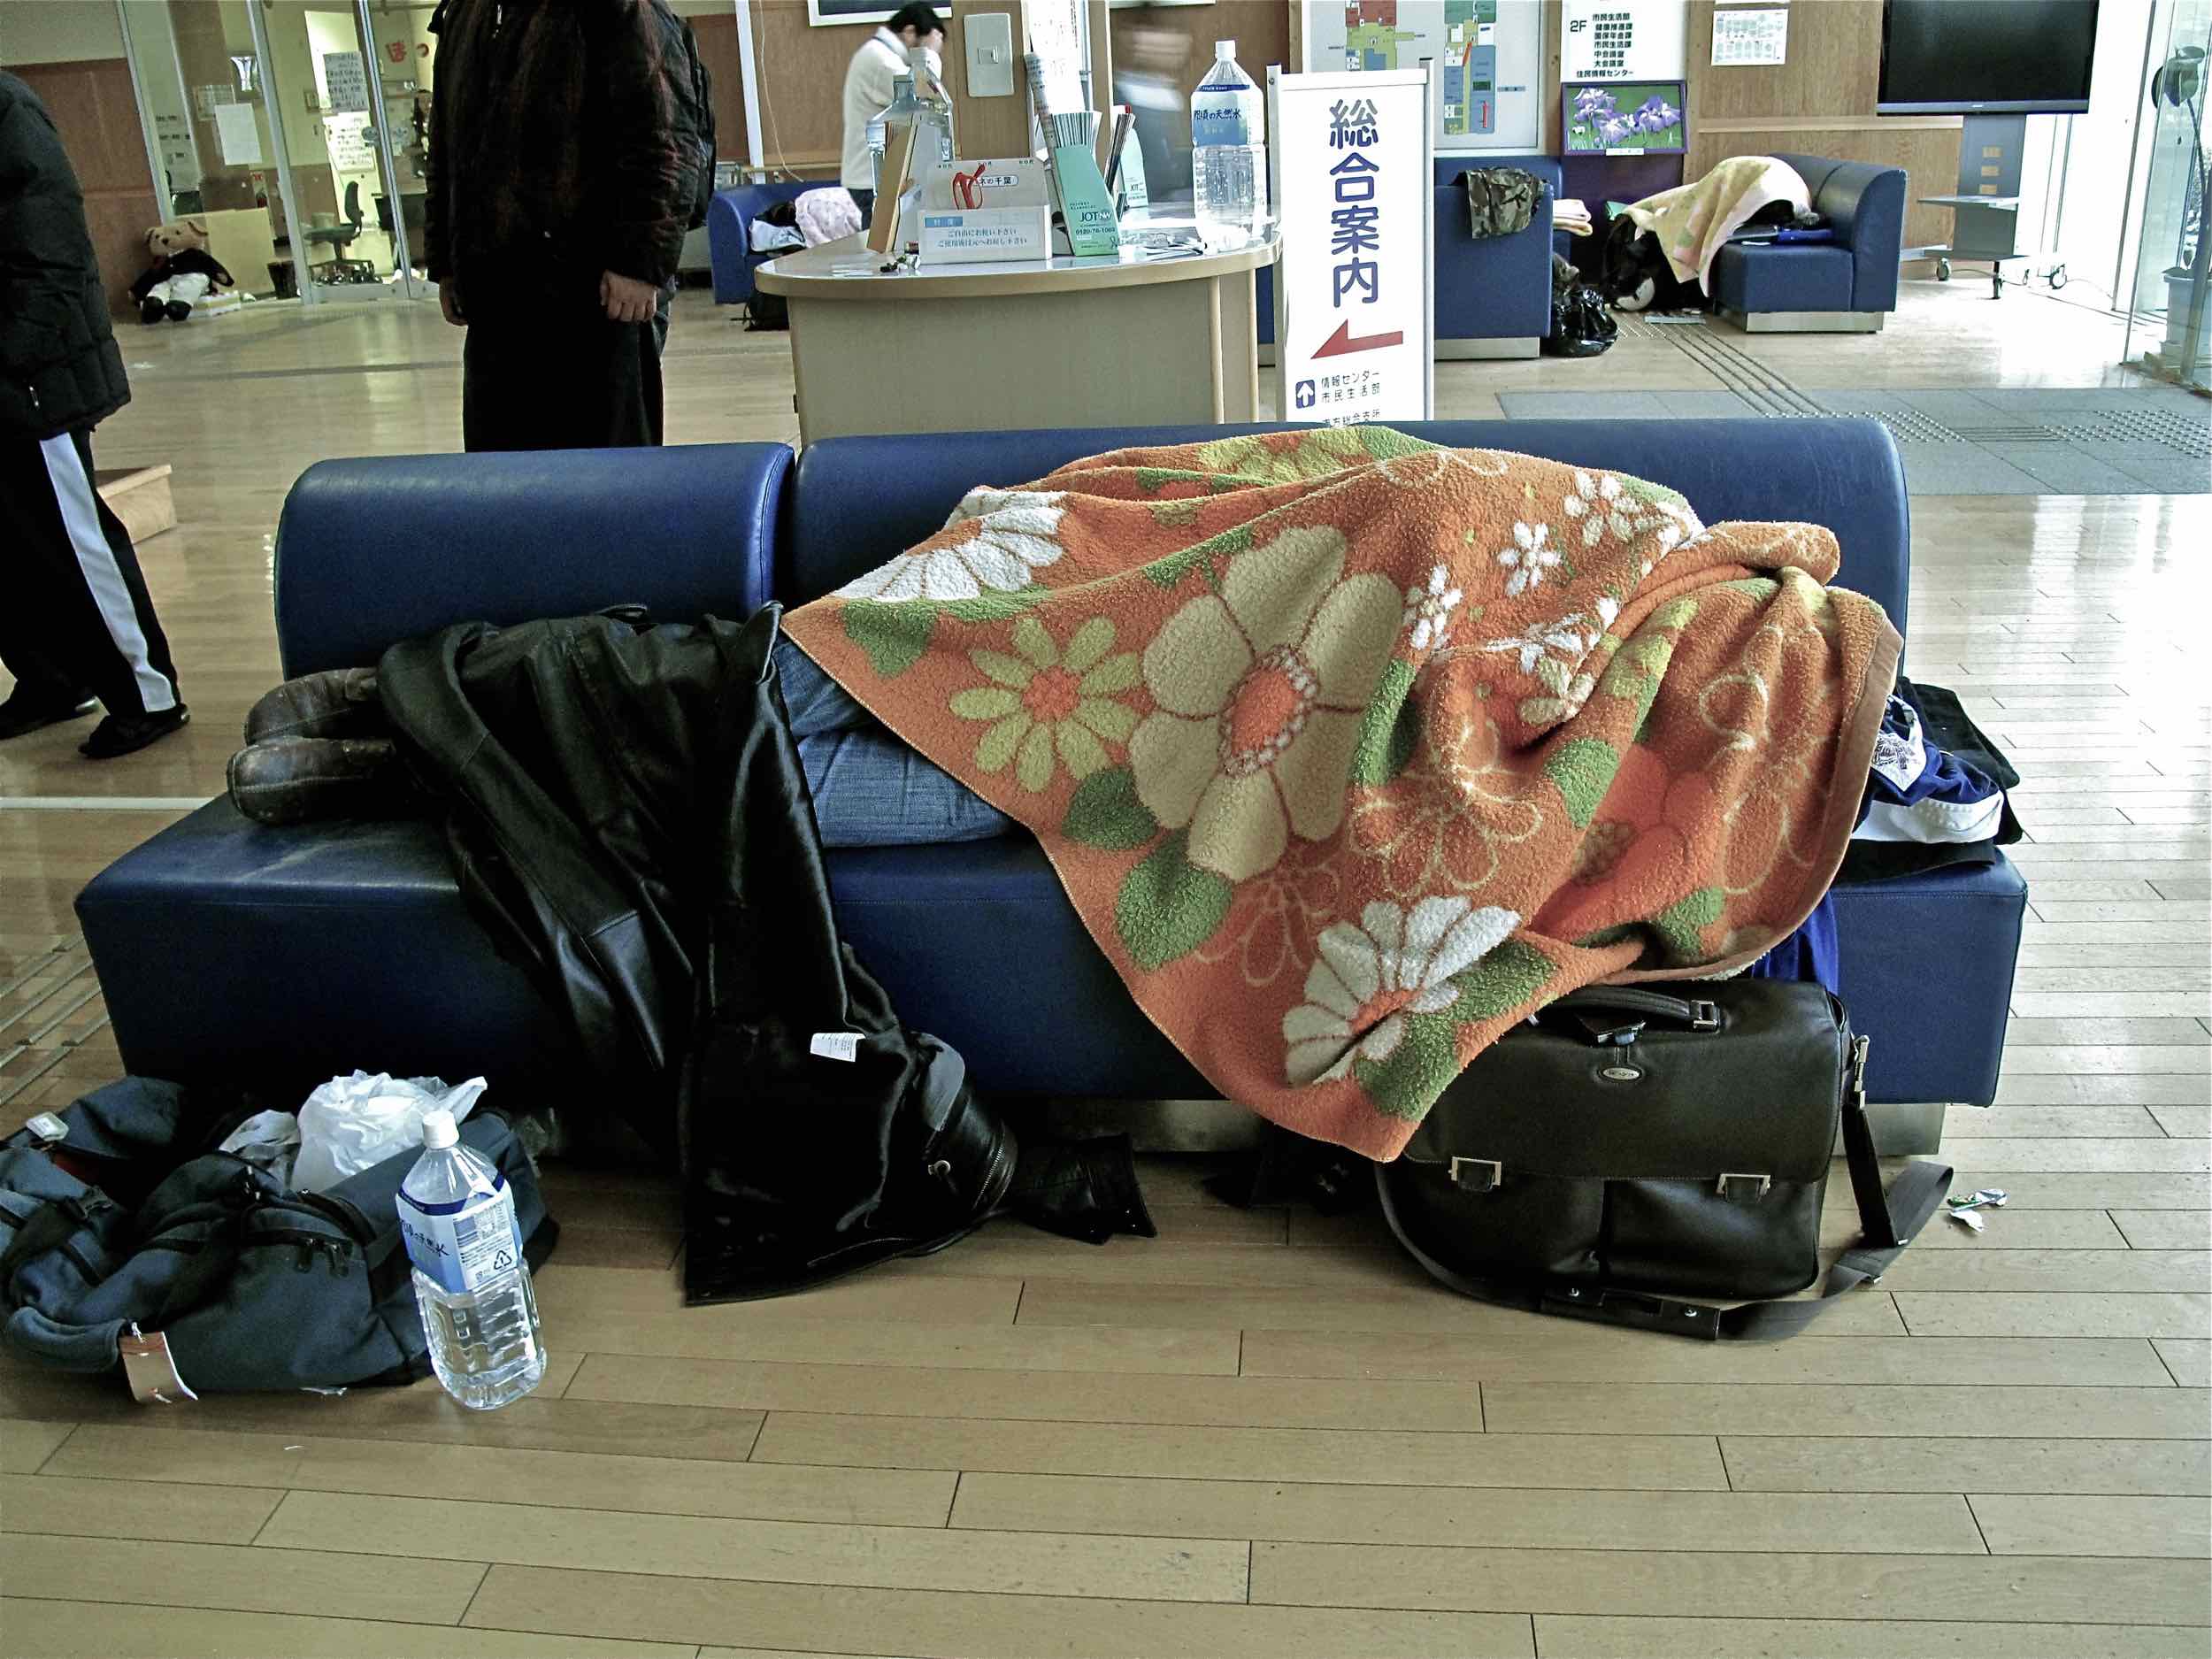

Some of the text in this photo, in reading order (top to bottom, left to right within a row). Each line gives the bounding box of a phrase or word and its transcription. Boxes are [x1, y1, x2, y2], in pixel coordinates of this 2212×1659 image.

[1593, 12, 1631, 21] 市民生活部
[1570, 19, 1587, 33] 2F
[1594, 59, 1624, 68] 大会議室
[1577, 69, 1634, 78] 住民情報センター
[1329, 98, 1380, 308] 総合案内
[1079, 211, 1098, 222] JOT
[1321, 369, 1380, 388] 情報センター
[1321, 382, 1380, 403] 市民生活部
